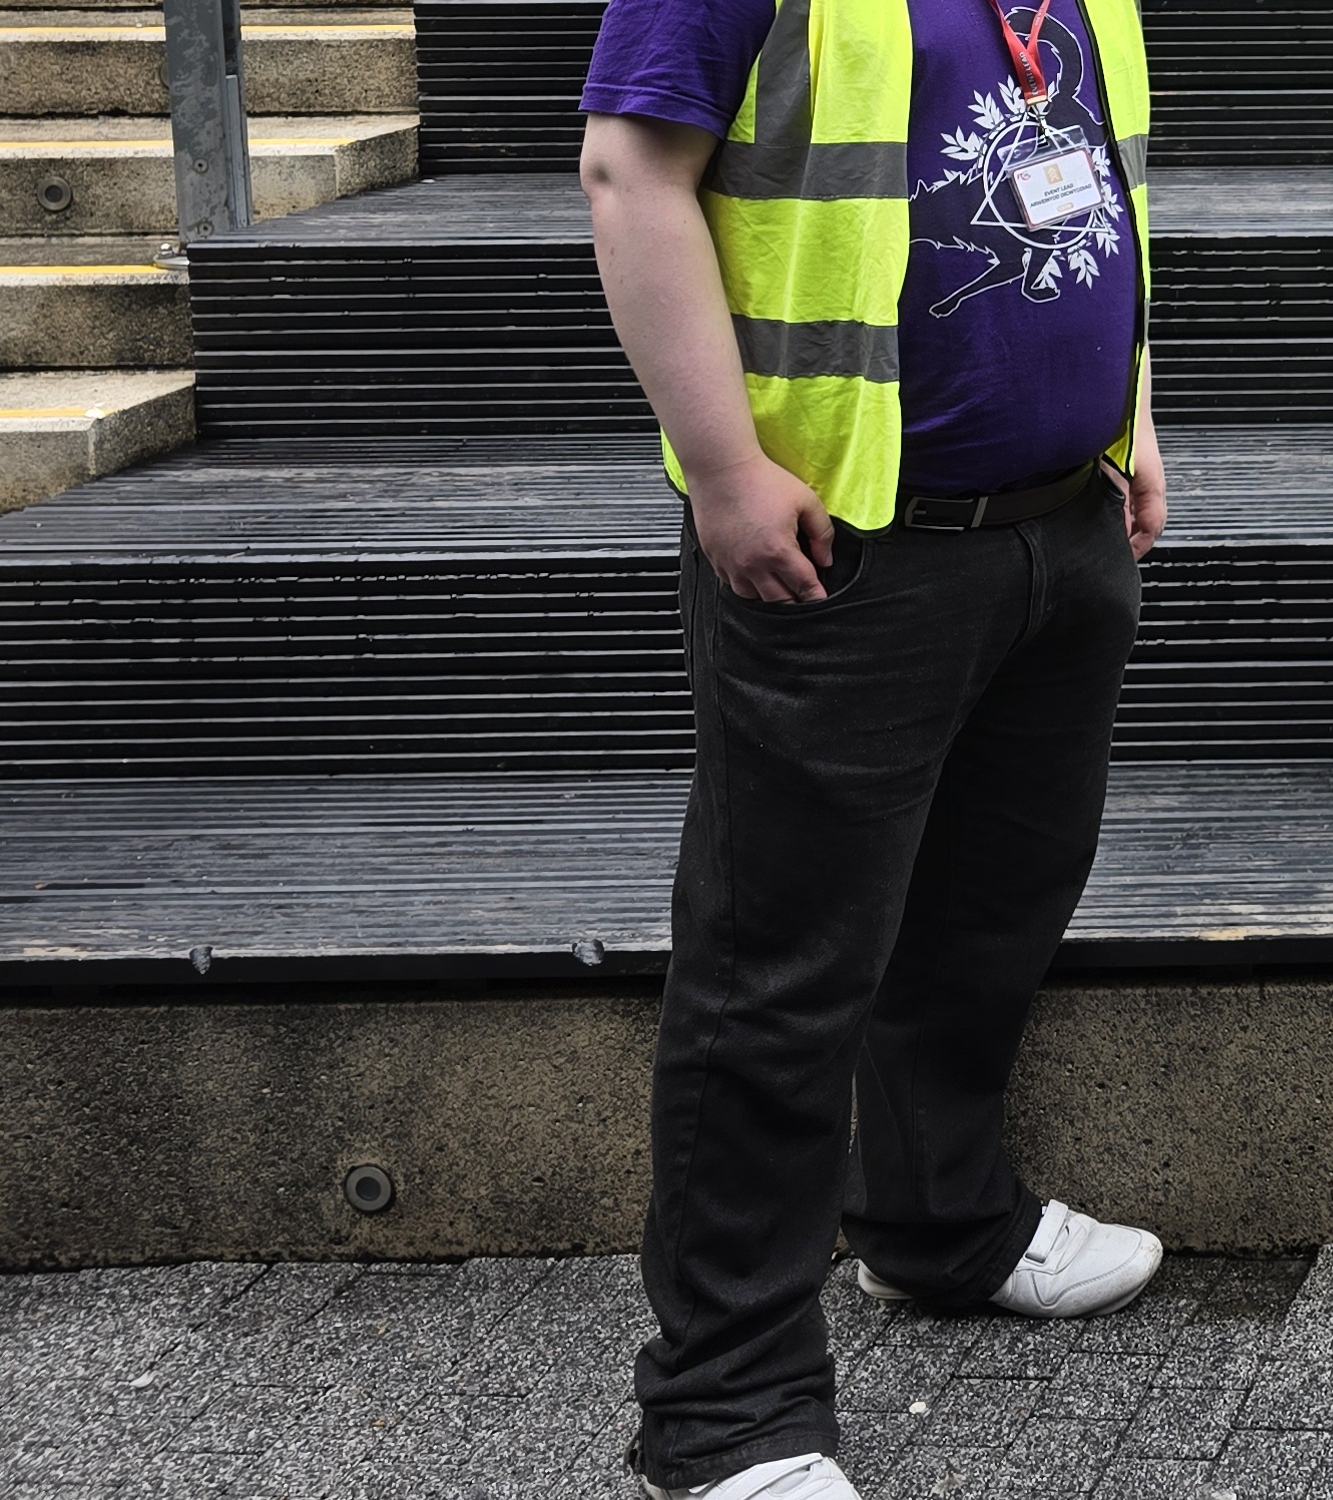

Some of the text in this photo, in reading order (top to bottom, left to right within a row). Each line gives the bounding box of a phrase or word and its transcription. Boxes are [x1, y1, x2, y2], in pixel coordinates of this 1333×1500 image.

[1019, 51, 1039, 96] EVENT LEAD
[1044, 189, 1059, 197] EVENT
